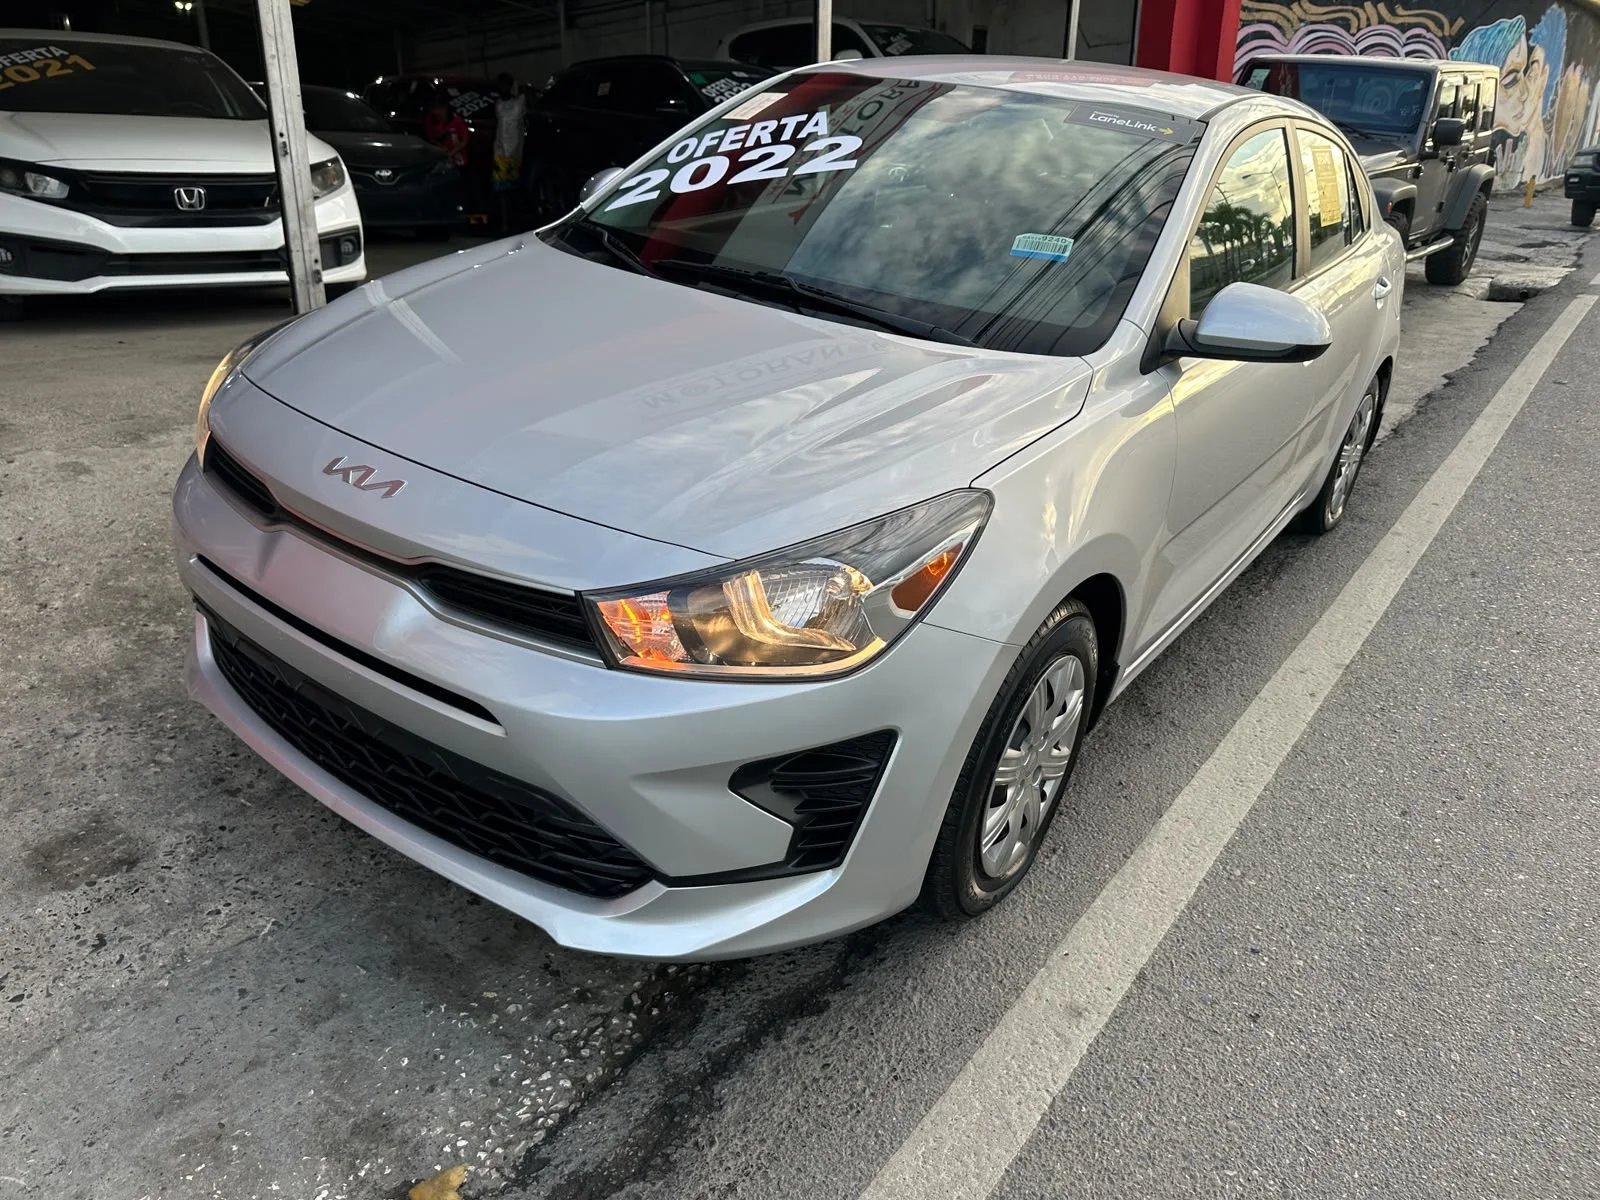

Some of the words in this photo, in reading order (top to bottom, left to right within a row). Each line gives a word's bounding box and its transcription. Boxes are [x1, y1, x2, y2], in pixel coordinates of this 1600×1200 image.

[0, 45, 70, 68] FERTA
[456, 95, 495, 118] 2021
[1089, 113, 1158, 132] LaneLink
[667, 111, 830, 165] OFERTA
[604, 135, 863, 212] 2022
